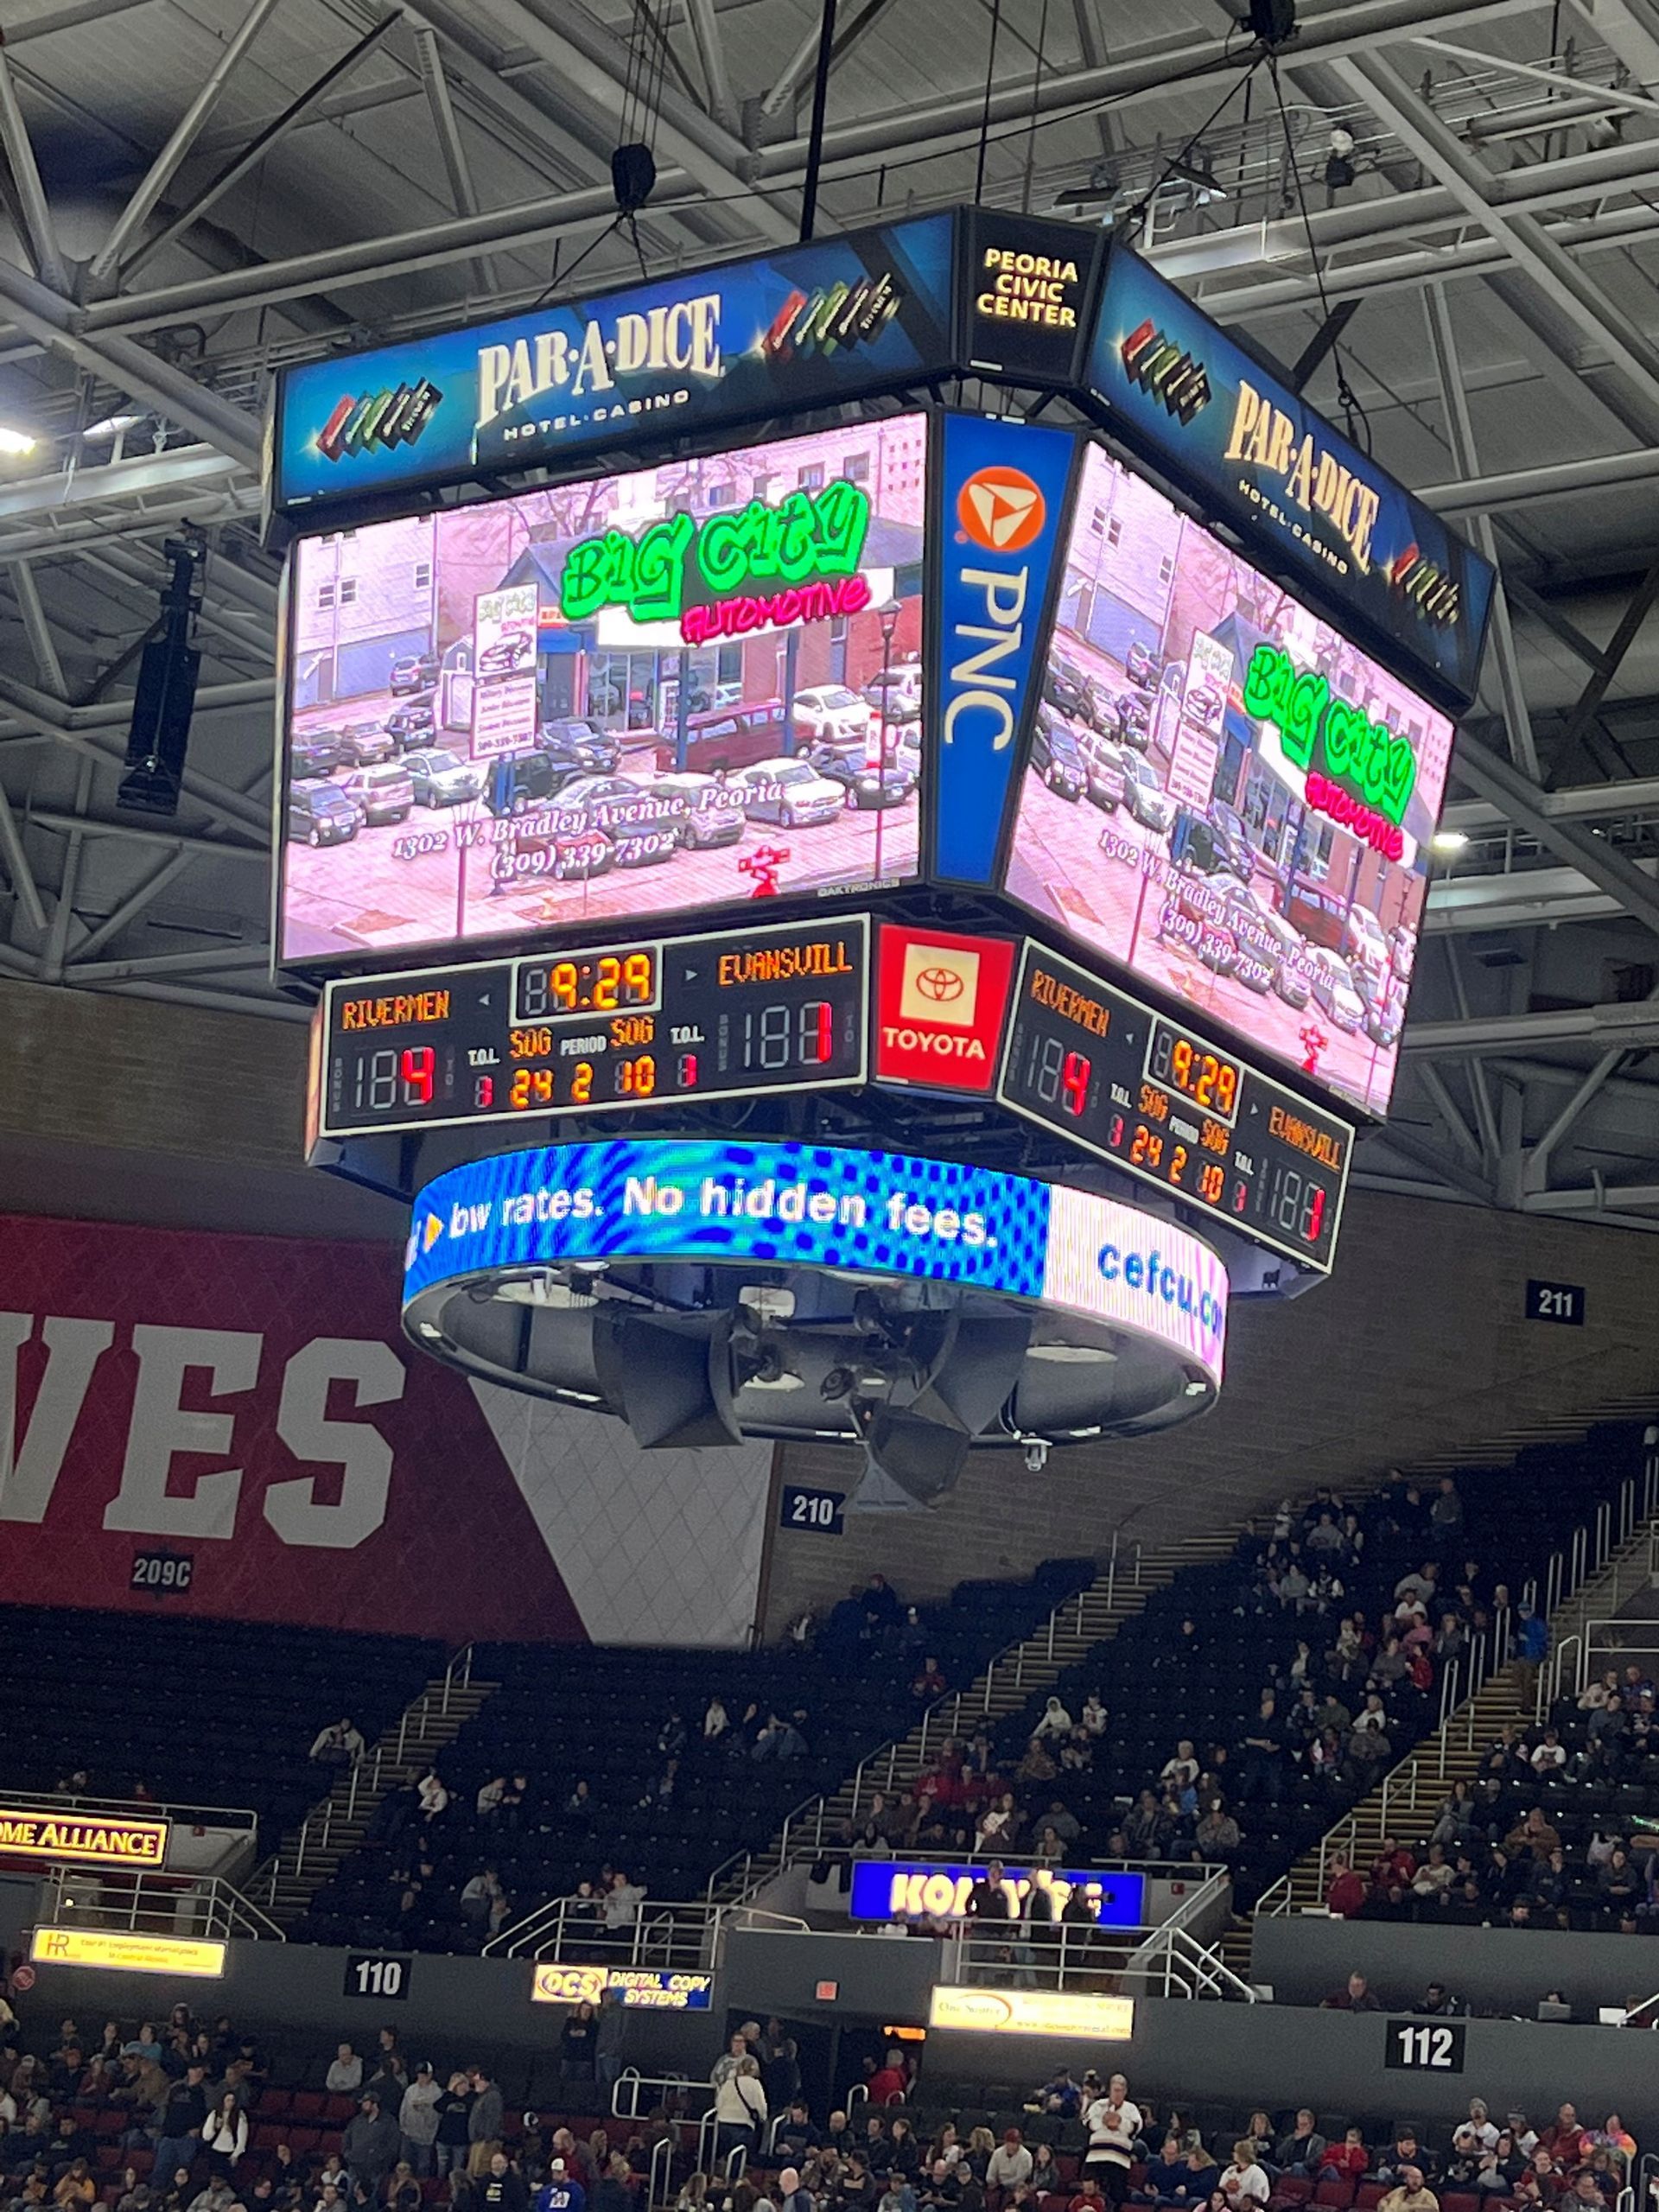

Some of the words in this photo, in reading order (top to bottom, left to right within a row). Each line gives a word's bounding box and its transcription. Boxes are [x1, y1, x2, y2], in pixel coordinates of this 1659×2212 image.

[985, 247, 1077, 283] PEORIA
[996, 274, 1065, 302] CIVIC
[977, 293, 1076, 327] CENTER
[681, 575, 872, 645] AUTOMOTIVE
[944, 566, 1028, 750] PNC
[392, 831, 446, 861] 1302
[492, 808, 588, 842] Bradley
[698, 781, 785, 813] Peoria
[490, 844, 556, 880] (309)
[560, 828, 676, 870] 339-7302
[1099, 830, 1139, 868] 1302
[1166, 865, 1225, 925] Bradley
[1287, 947, 1335, 990] Peoria
[550, 953, 650, 1010] 9:29
[719, 941, 854, 986] EVANSVILL
[341, 990, 449, 1030] RIVERMEN
[509, 1026, 553, 1058] SOG
[560, 1035, 607, 1057] PERIOD
[609, 1014, 655, 1047] SOG
[882, 1026, 986, 1060] TOYOTA
[509, 1068, 554, 1110] 24
[571, 1062, 594, 1103] 2
[1172, 1039, 1236, 1113] 9:29
[1168, 1145, 1188, 1185] 2
[501, 1185, 605, 1227] rates.
[622, 1175, 685, 1217] No
[700, 1177, 868, 1230] hidden
[885, 1190, 998, 1249] fees.
[1538, 1288, 1573, 1317] 211
[0, 1310, 407, 1548] VES
[791, 1494, 834, 1525] 210
[132, 1557, 193, 1588] 209C
[37, 1822, 158, 1856] ALLIANCE
[355, 1960, 402, 1995] 110
[608, 1971, 664, 1989] DIGITAL
[668, 1974, 711, 1993] COPY
[623, 1988, 689, 2006] SYSTEMS
[1397, 2026, 1453, 2067] 112
